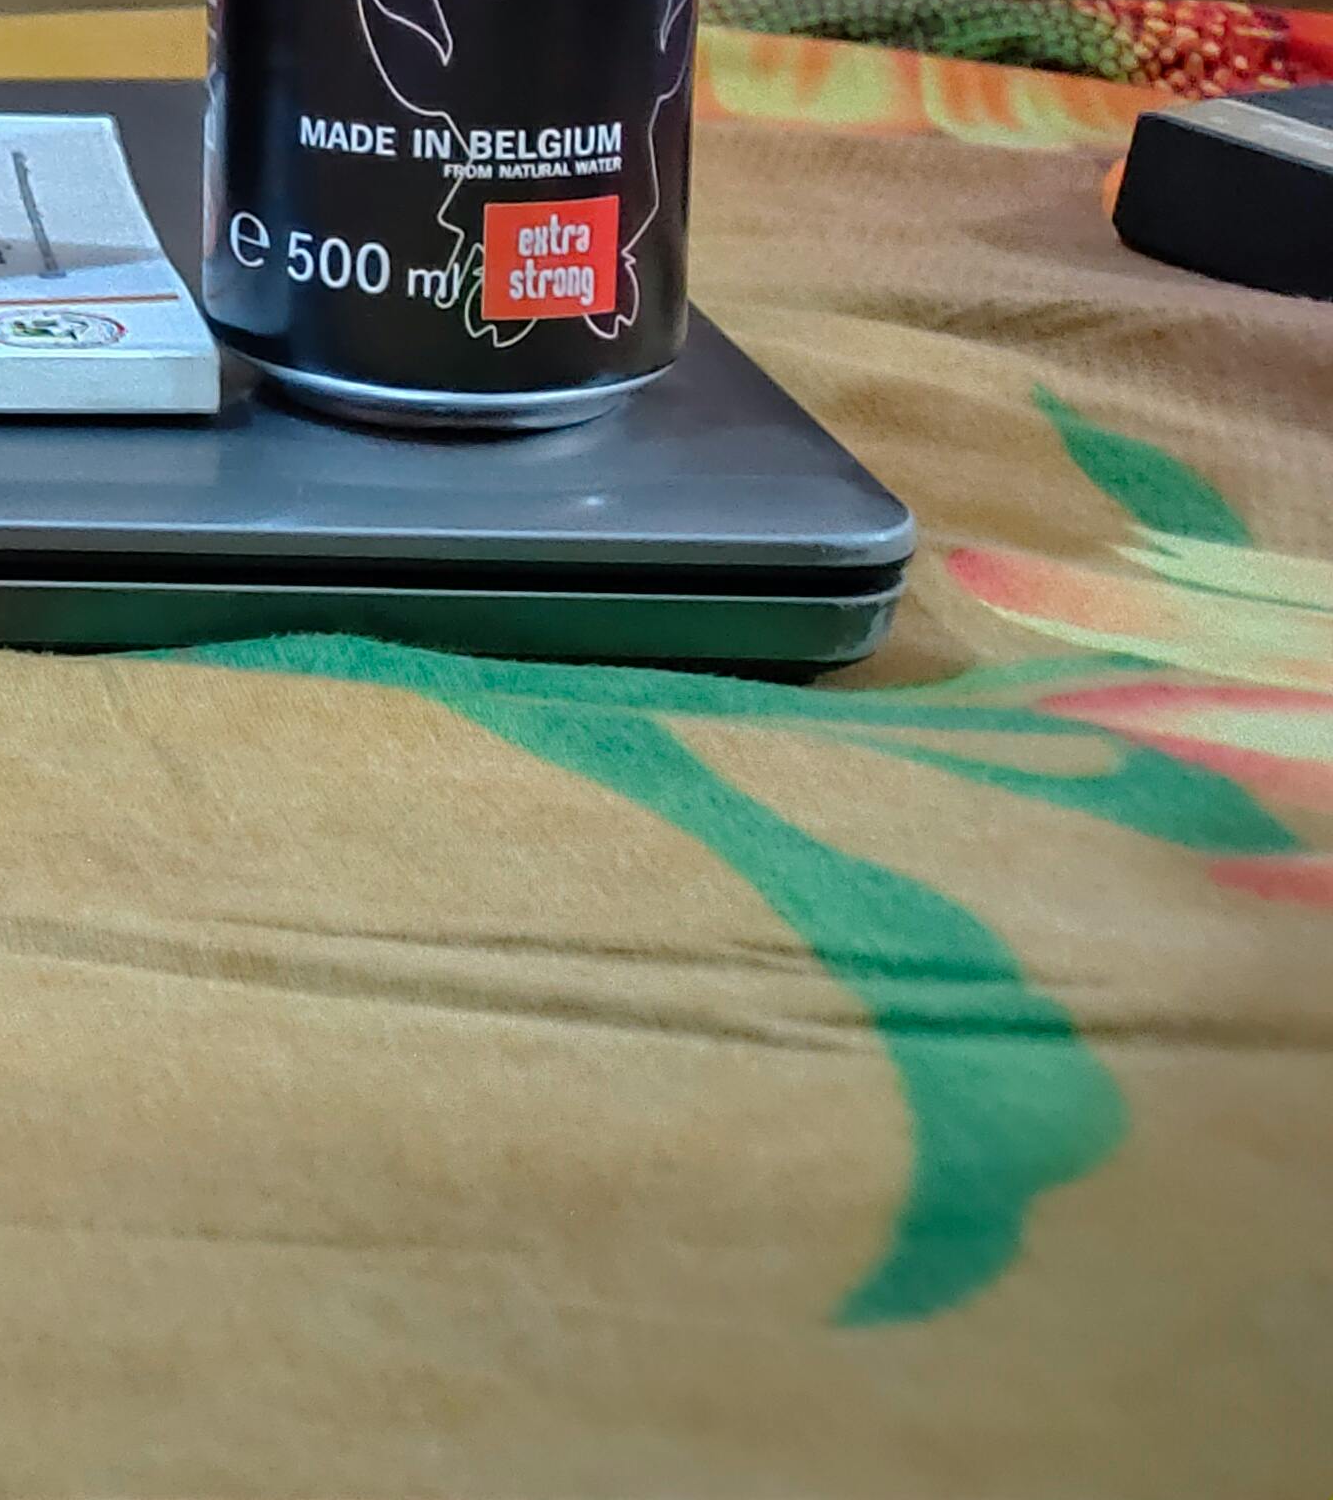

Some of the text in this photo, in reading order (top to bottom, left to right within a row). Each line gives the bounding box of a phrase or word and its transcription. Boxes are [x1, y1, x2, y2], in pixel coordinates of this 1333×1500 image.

[299, 115, 623, 160] MADE IN BELGIUM
[444, 156, 623, 180] FROM NATURAL WATER
[517, 214, 590, 256] extra
[286, 230, 391, 294] 500
[407, 264, 460, 300] ml
[508, 258, 595, 306] strong
